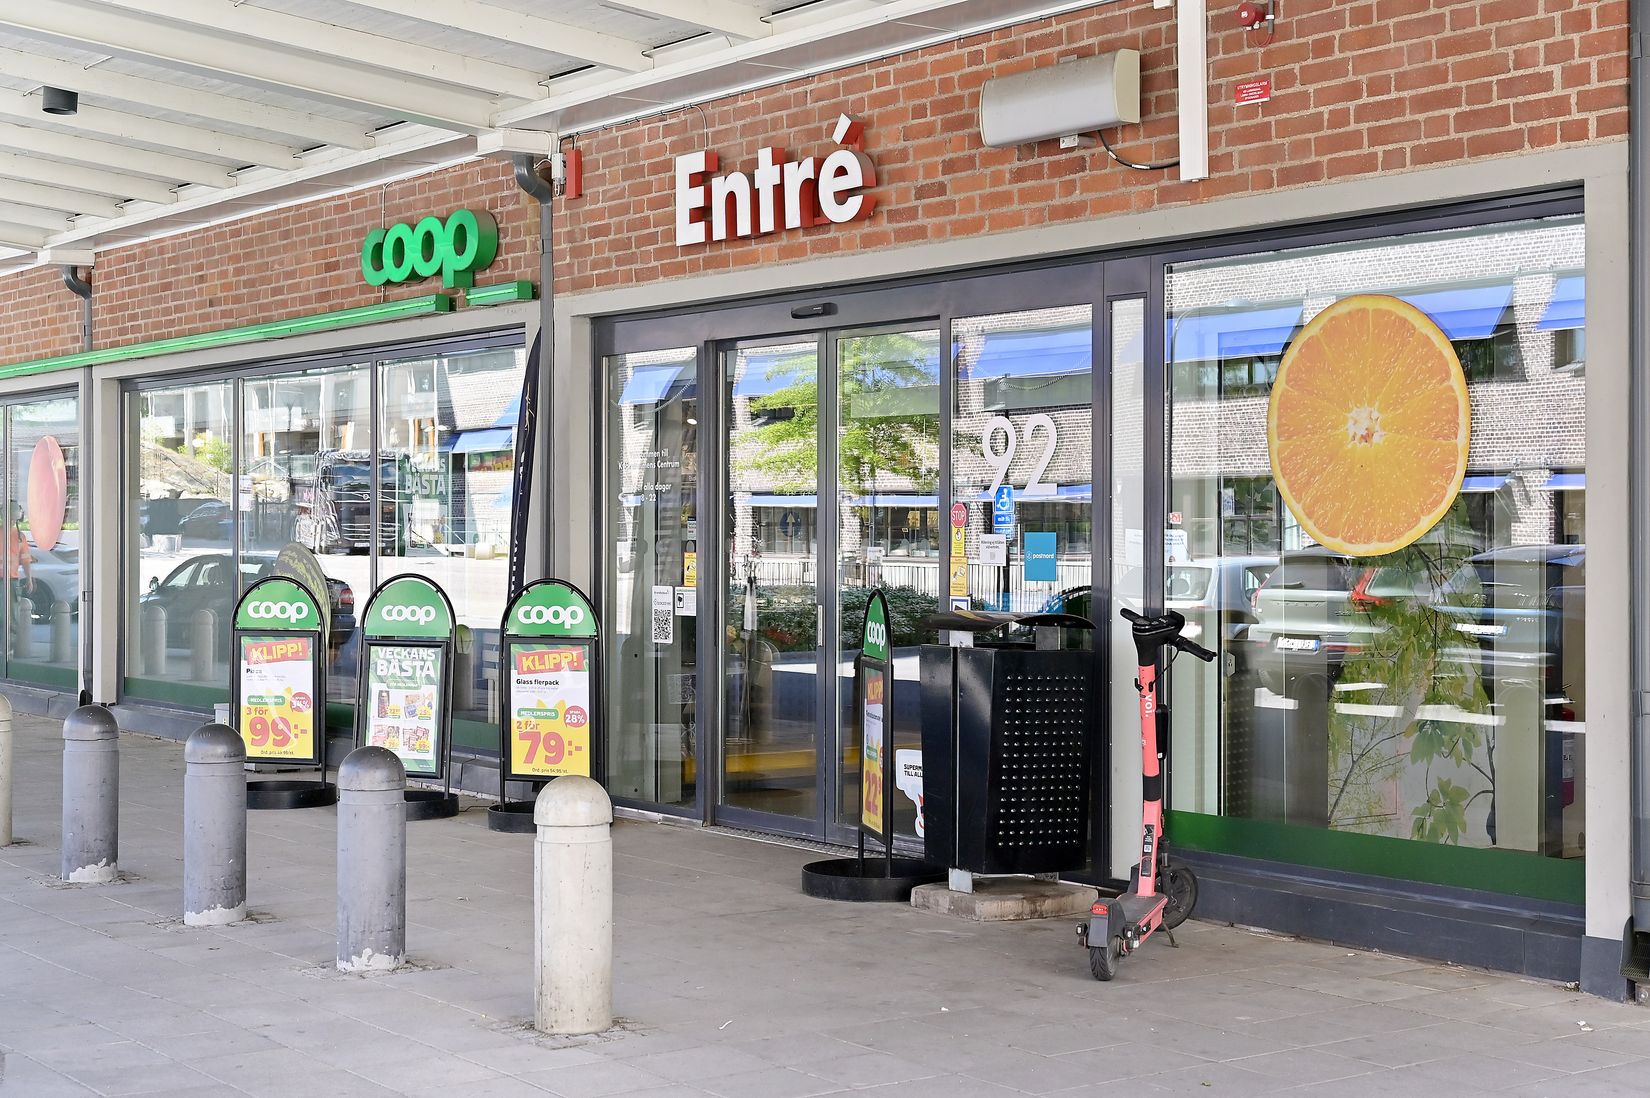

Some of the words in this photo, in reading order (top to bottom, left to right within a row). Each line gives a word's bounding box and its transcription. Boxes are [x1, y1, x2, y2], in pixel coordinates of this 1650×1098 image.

[675, 112, 865, 246] Entré
[361, 208, 484, 289] coop
[657, 460, 680, 470] Centrum
[982, 413, 1058, 498] 92
[405, 473, 447, 495] BÄSTA
[643, 482, 654, 491] alla
[655, 482, 672, 493] dagar
[649, 493, 657, 502] 22
[951, 510, 965, 521] STOP
[247, 601, 309, 624] coop
[381, 605, 436, 625] coop
[517, 605, 584, 629] coop
[867, 620, 886, 652] coop
[250, 641, 303, 662] KLIPP!
[378, 648, 436, 660] VECKANS
[376, 659, 436, 677] BÄSTA
[521, 651, 579, 673] KLIPP!
[246, 707, 252, 716] 3
[254, 706, 269, 716] för
[565, 714, 585, 724] 28%
[516, 720, 522, 730] 2
